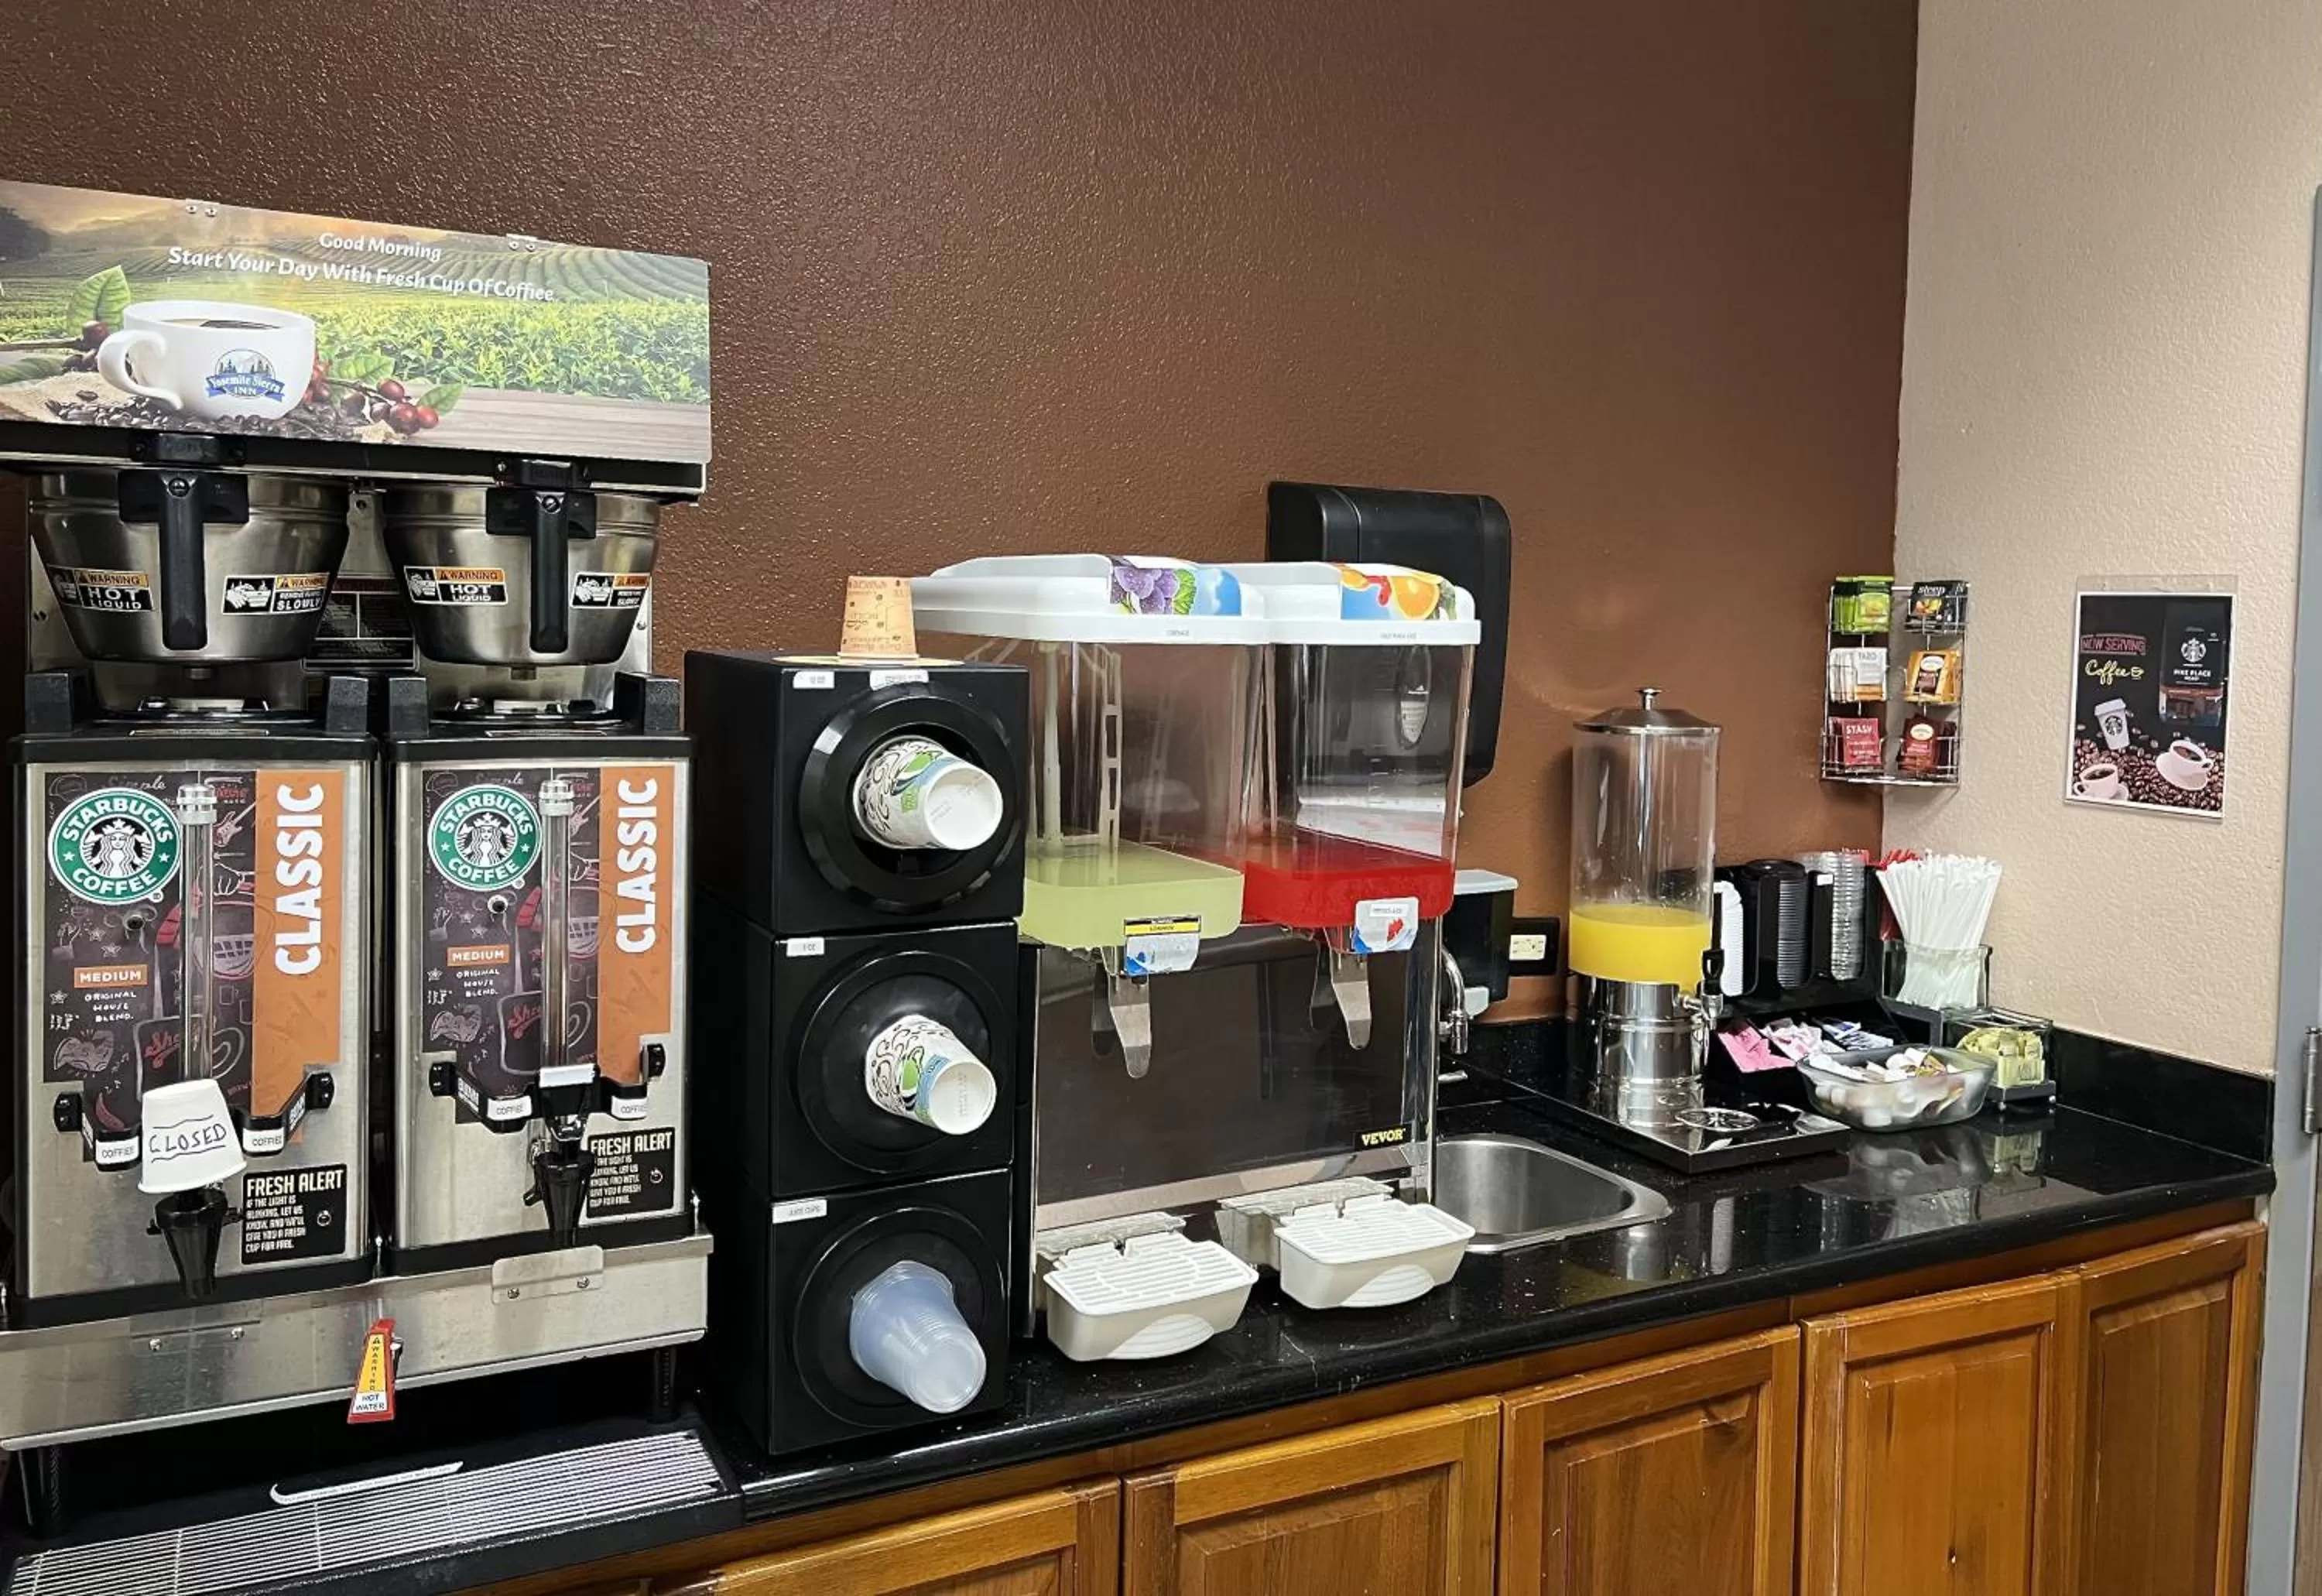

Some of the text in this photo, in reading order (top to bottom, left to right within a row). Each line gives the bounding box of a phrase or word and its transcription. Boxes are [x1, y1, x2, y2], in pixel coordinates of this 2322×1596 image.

[319, 232, 441, 263] Good Morning
[168, 247, 224, 269] Start
[228, 253, 275, 272] Your
[279, 258, 319, 281] Day
[323, 263, 372, 287] With
[375, 269, 425, 289] Fresh
[430, 275, 464, 296] Cup
[468, 278, 494, 297] Of
[88, 574, 140, 584] WARNING
[88, 587, 139, 601] HOT
[450, 584, 491, 594] HOT
[91, 600, 142, 609] LIQUID
[276, 598, 321, 611] SLOWLY
[2105, 638, 2144, 652] SERVING
[2084, 659, 2131, 685] Coffee
[62, 798, 174, 843] STARBUCKS
[440, 793, 533, 835] STARBUCKS
[448, 858, 520, 883] COFFEE
[615, 778, 657, 954] CLASSIC
[72, 867, 157, 896] COFFEE
[274, 783, 324, 975] CLASSIC
[453, 950, 504, 962] MEDIUM
[80, 971, 141, 983] MEDIUM
[456, 968, 500, 978] ORIGINAL
[84, 992, 136, 1002] ORIGINAL
[496, 1105, 523, 1115] COFFEE
[149, 1123, 227, 1153] CLOSED
[252, 1135, 283, 1146] COFFEE
[591, 1132, 673, 1156] FRESH ALERT
[1361, 1129, 1403, 1146] VEVOR
[102, 1146, 135, 1158] COFFEE
[247, 1170, 344, 1197] FRESH ALERT
[255, 1197, 267, 1207] THE
[268, 1196, 287, 1207] LIGHT
[289, 1194, 296, 1204] IS
[281, 1206, 292, 1216] LET
[246, 1242, 261, 1253] CUP
[369, 1346, 378, 1390] WARNING
[356, 1402, 385, 1411] WATER
